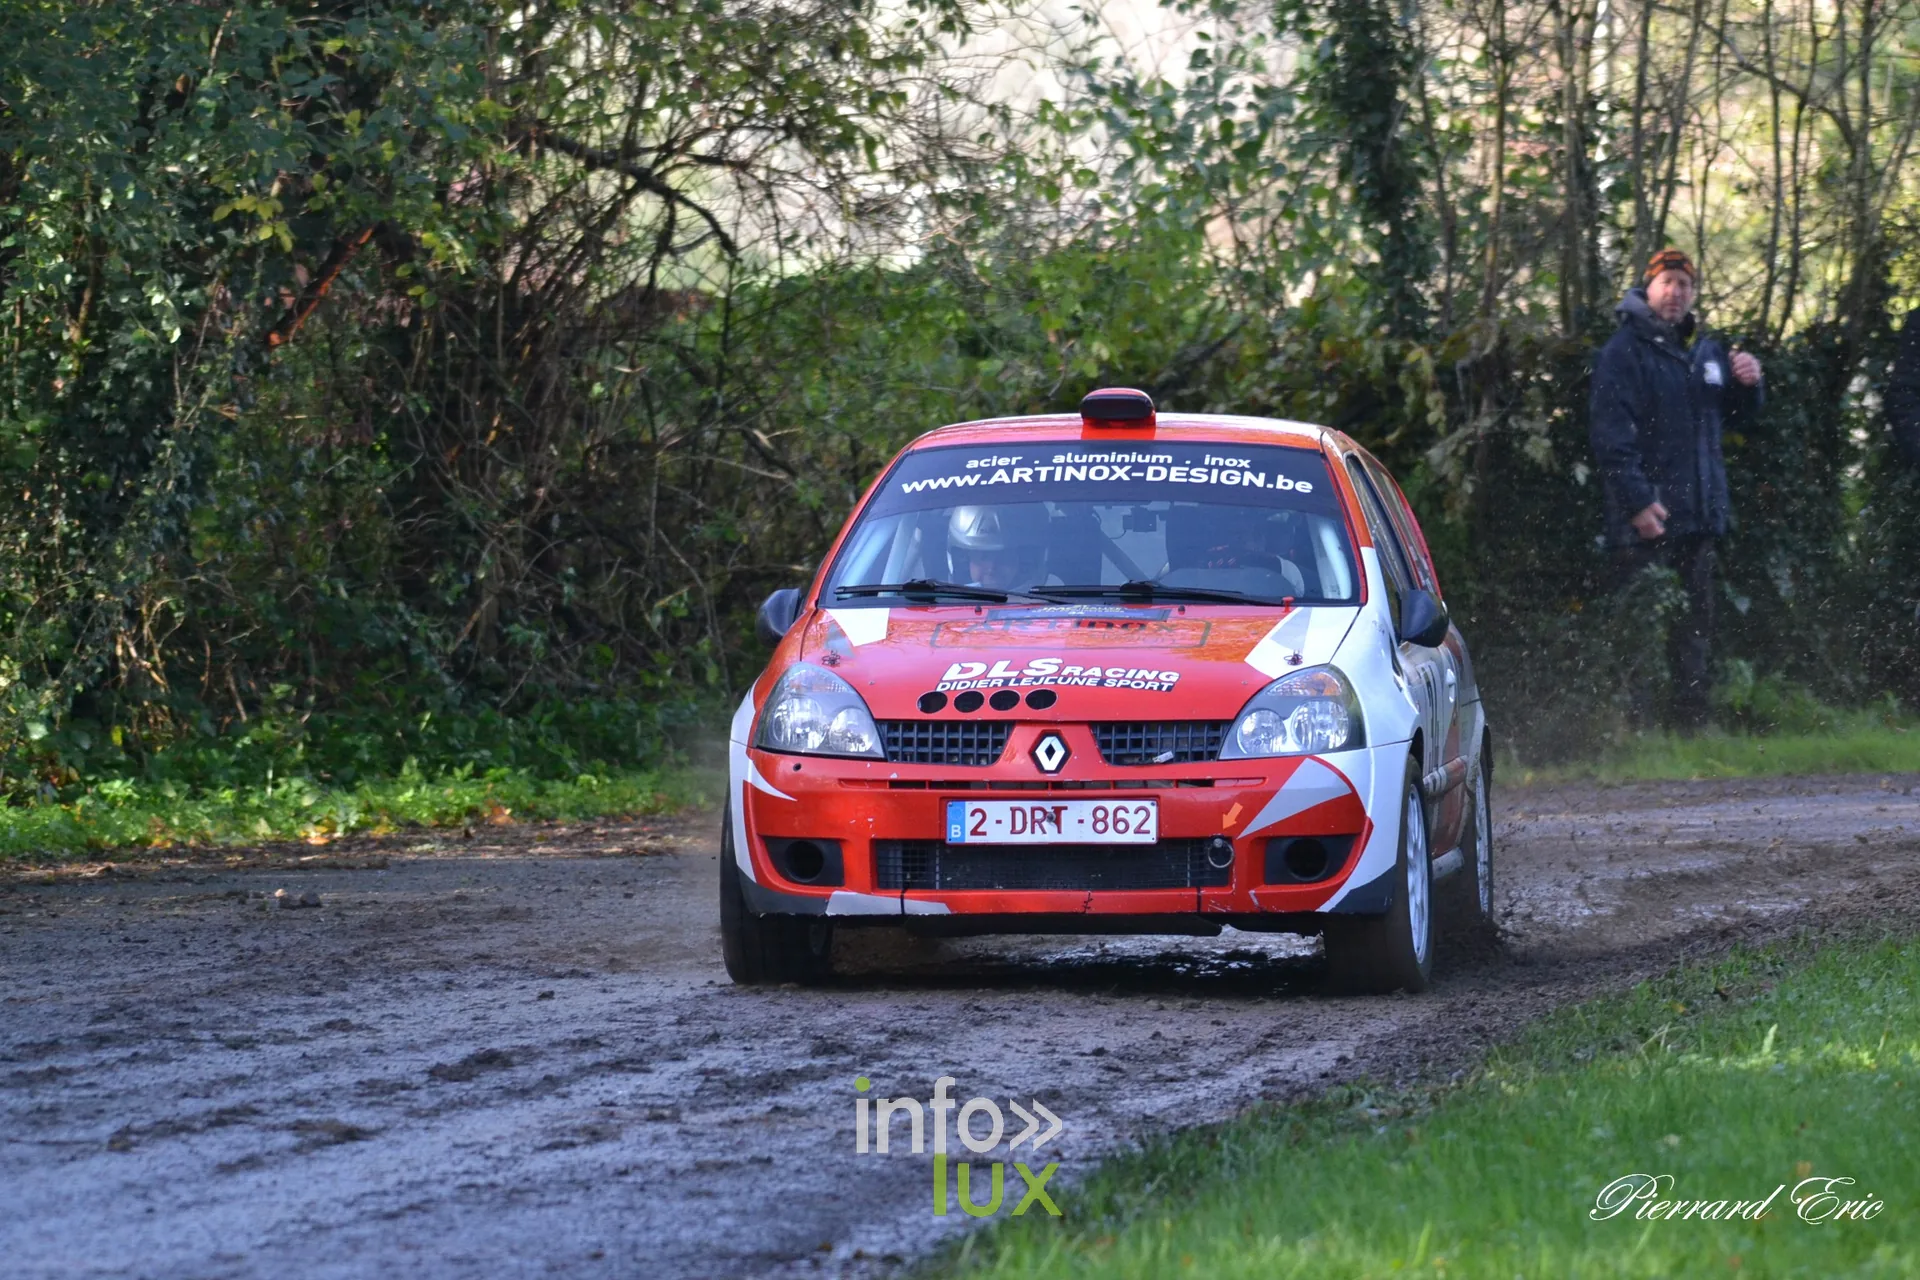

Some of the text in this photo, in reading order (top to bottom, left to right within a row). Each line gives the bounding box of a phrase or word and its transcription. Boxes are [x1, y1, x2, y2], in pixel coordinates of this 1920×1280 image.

[965, 455, 1023, 469] acier
[1052, 452, 1173, 465] aluminium
[1204, 454, 1251, 469] inox
[901, 466, 1314, 494] www.ARTINOX-DESIGN.be
[941, 657, 1180, 683] DLS RACING
[936, 679, 1004, 692] DIDIER
[1103, 679, 1174, 692] SPORT
[951, 825, 962, 838] B
